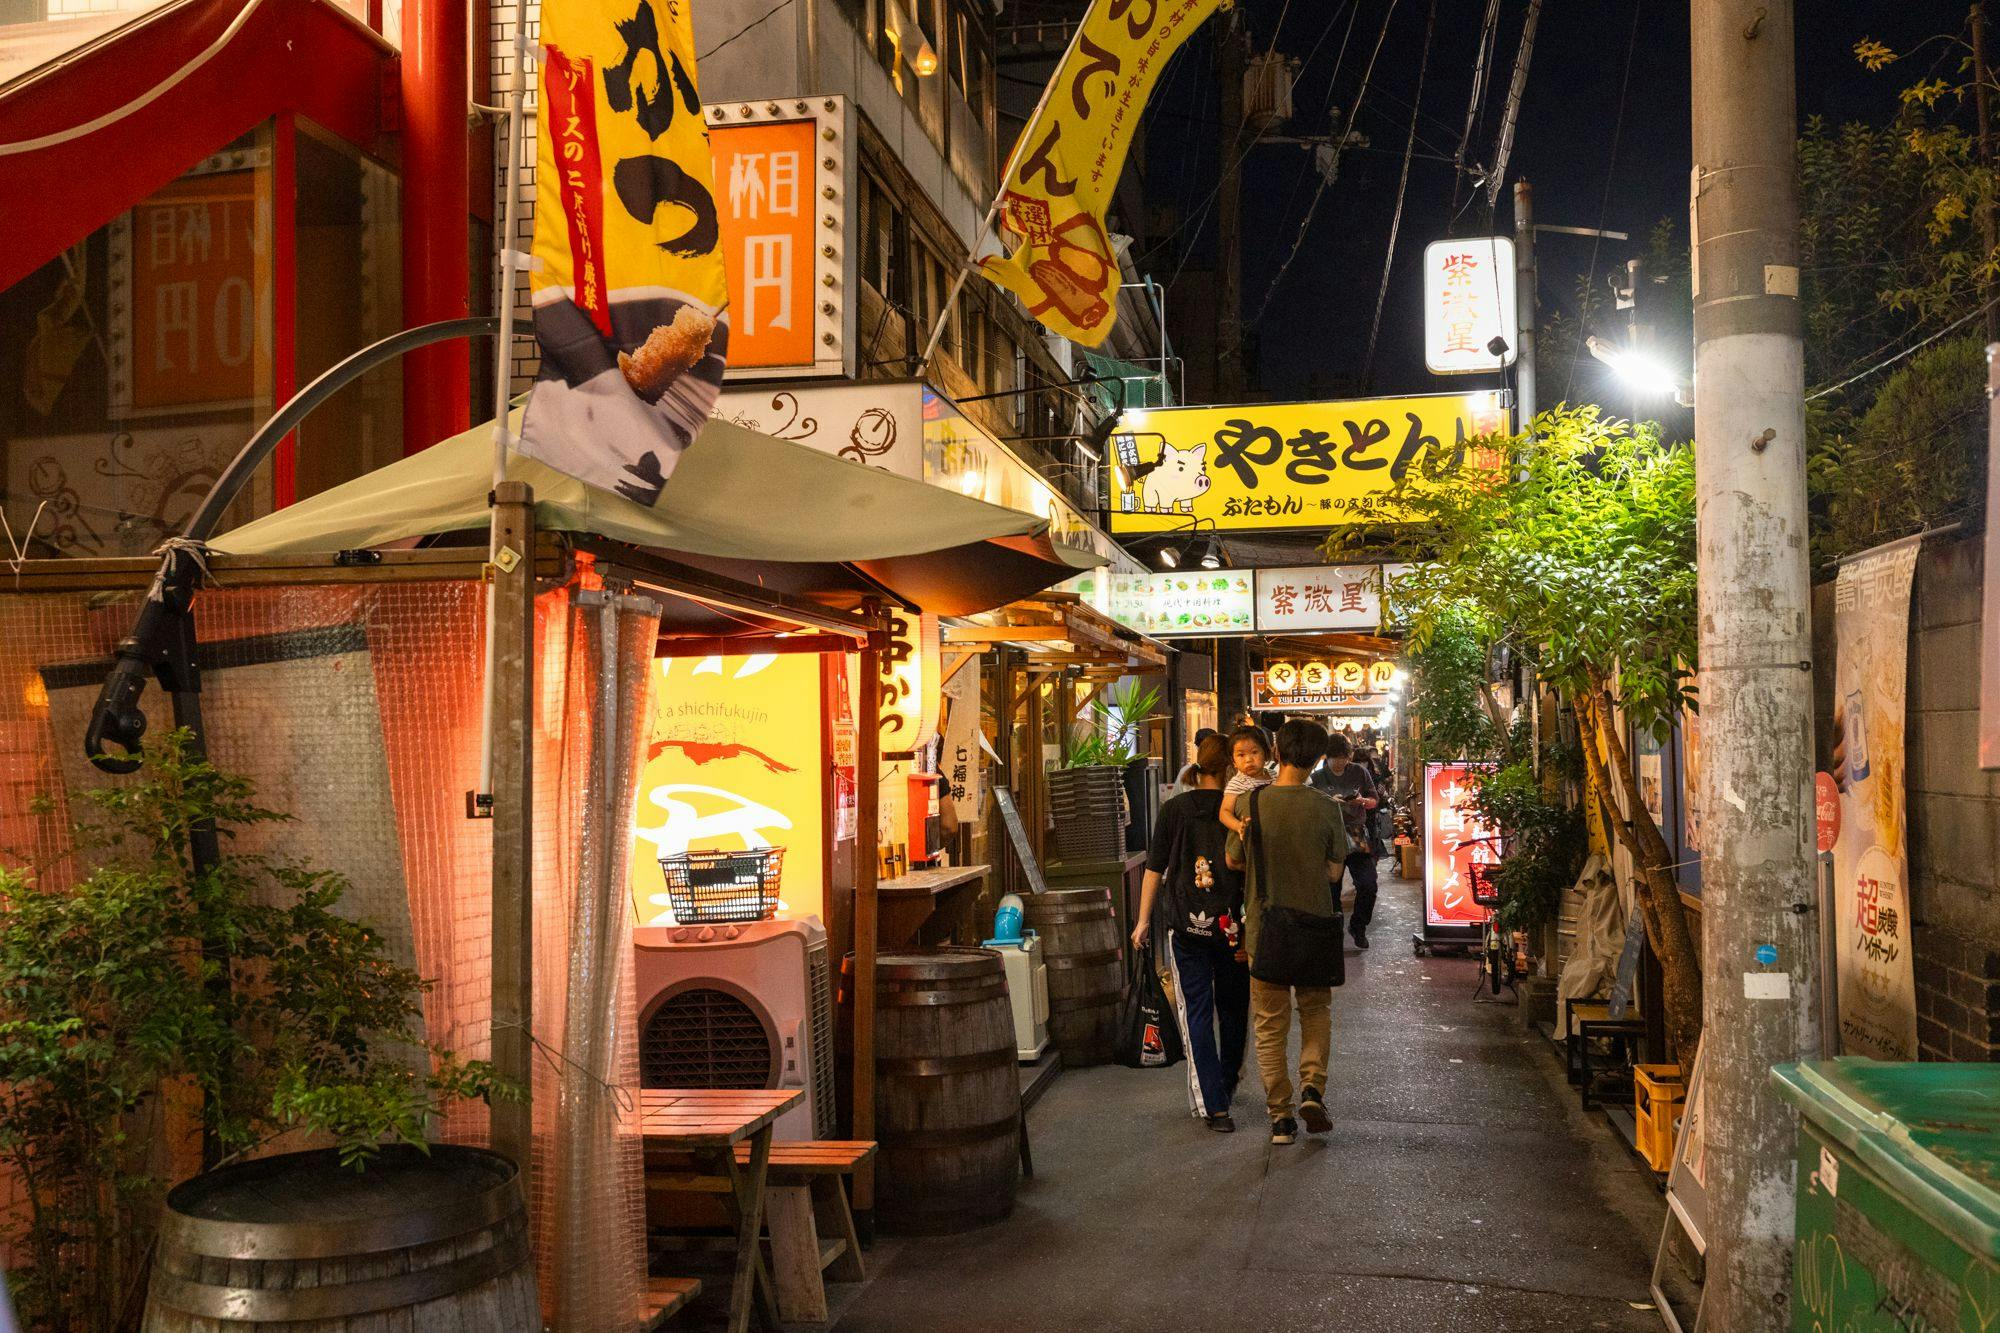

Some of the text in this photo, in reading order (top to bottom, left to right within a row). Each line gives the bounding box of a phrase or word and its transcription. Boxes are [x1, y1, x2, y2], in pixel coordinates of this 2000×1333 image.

[602, 0, 717, 258] かつ
[712, 152, 799, 220] 杯目
[743, 233, 792, 336] 円
[1213, 412, 1466, 489] やきとん
[1222, 494, 1303, 516] ぶたもん
[1271, 582, 1368, 616] 紫微星
[1274, 666, 1392, 684] やきとん
[678, 702, 768, 724] shichifukujin
[951, 745, 968, 802] 七福神
[1439, 780, 1465, 909] 中国ラーメン
[1186, 926, 1213, 937] adidas
[1857, 933, 1899, 964] ハイボール
